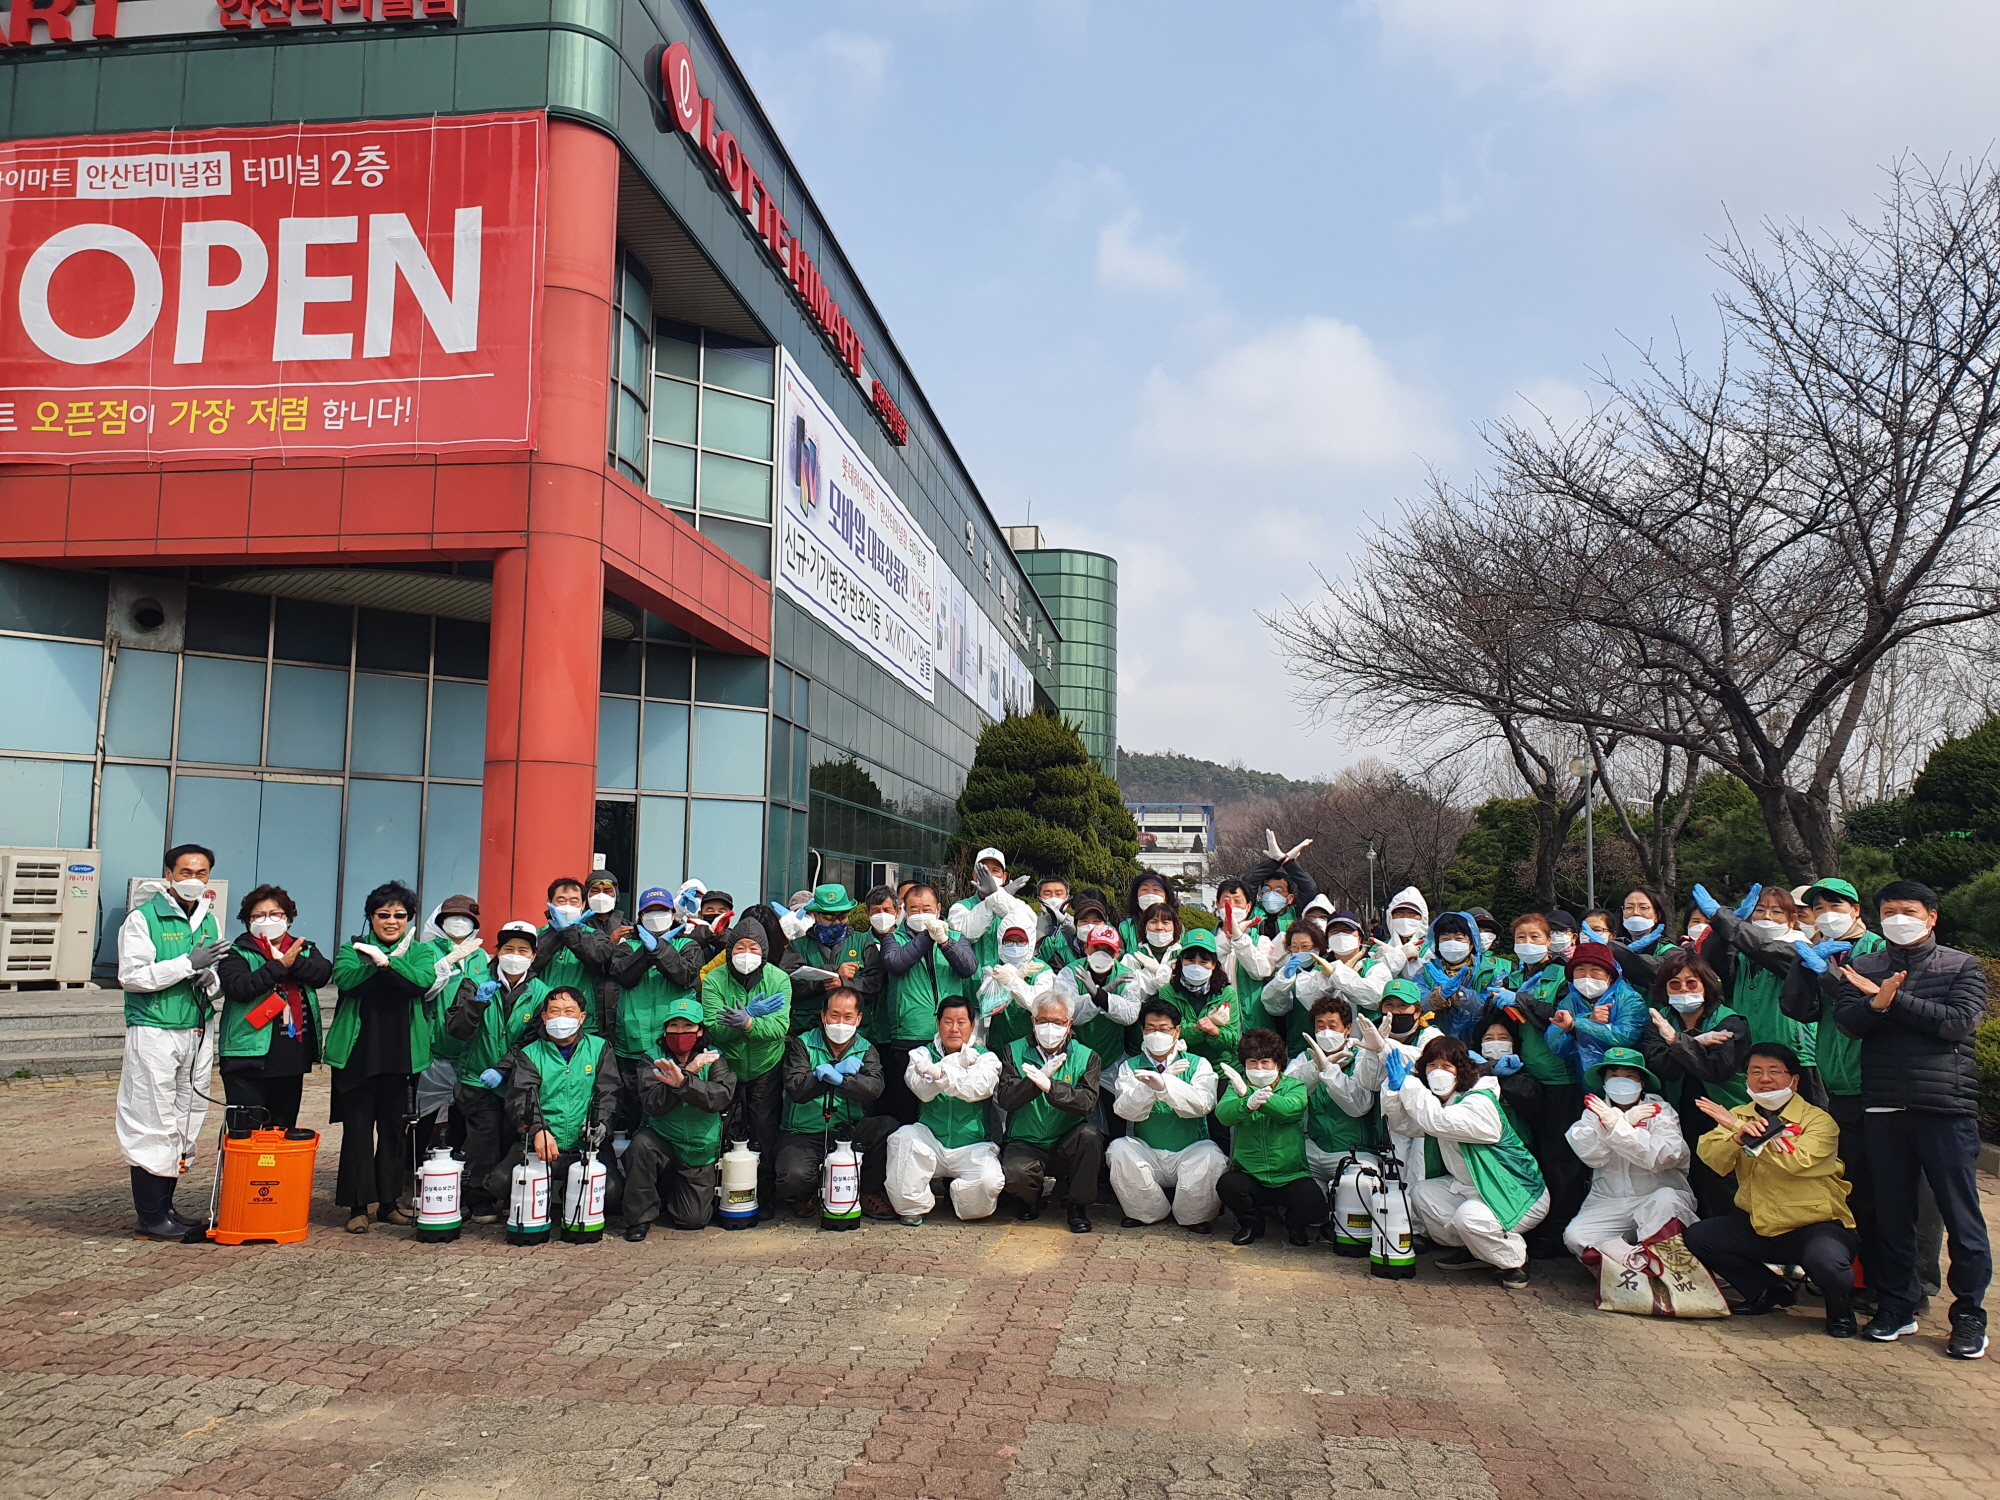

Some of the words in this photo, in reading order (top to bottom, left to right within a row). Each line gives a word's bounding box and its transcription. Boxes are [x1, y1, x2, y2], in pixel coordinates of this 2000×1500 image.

[86, 159, 222, 190] 안산터미널점
[243, 154, 320, 187] 터미널
[331, 146, 390, 187] 2층
[701, 98, 789, 268] LOTTE
[789, 236, 866, 379] HIMART
[19, 205, 483, 365] OPEN
[31, 399, 155, 436] 오픈점이
[168, 399, 235, 435] 가장
[246, 396, 309, 432] 저렴
[322, 396, 412, 430] 합니다!
[828, 479, 866, 565] 모바일
[867, 525, 908, 604] 대표상품전
[68, 874, 94, 882] 캐리어
